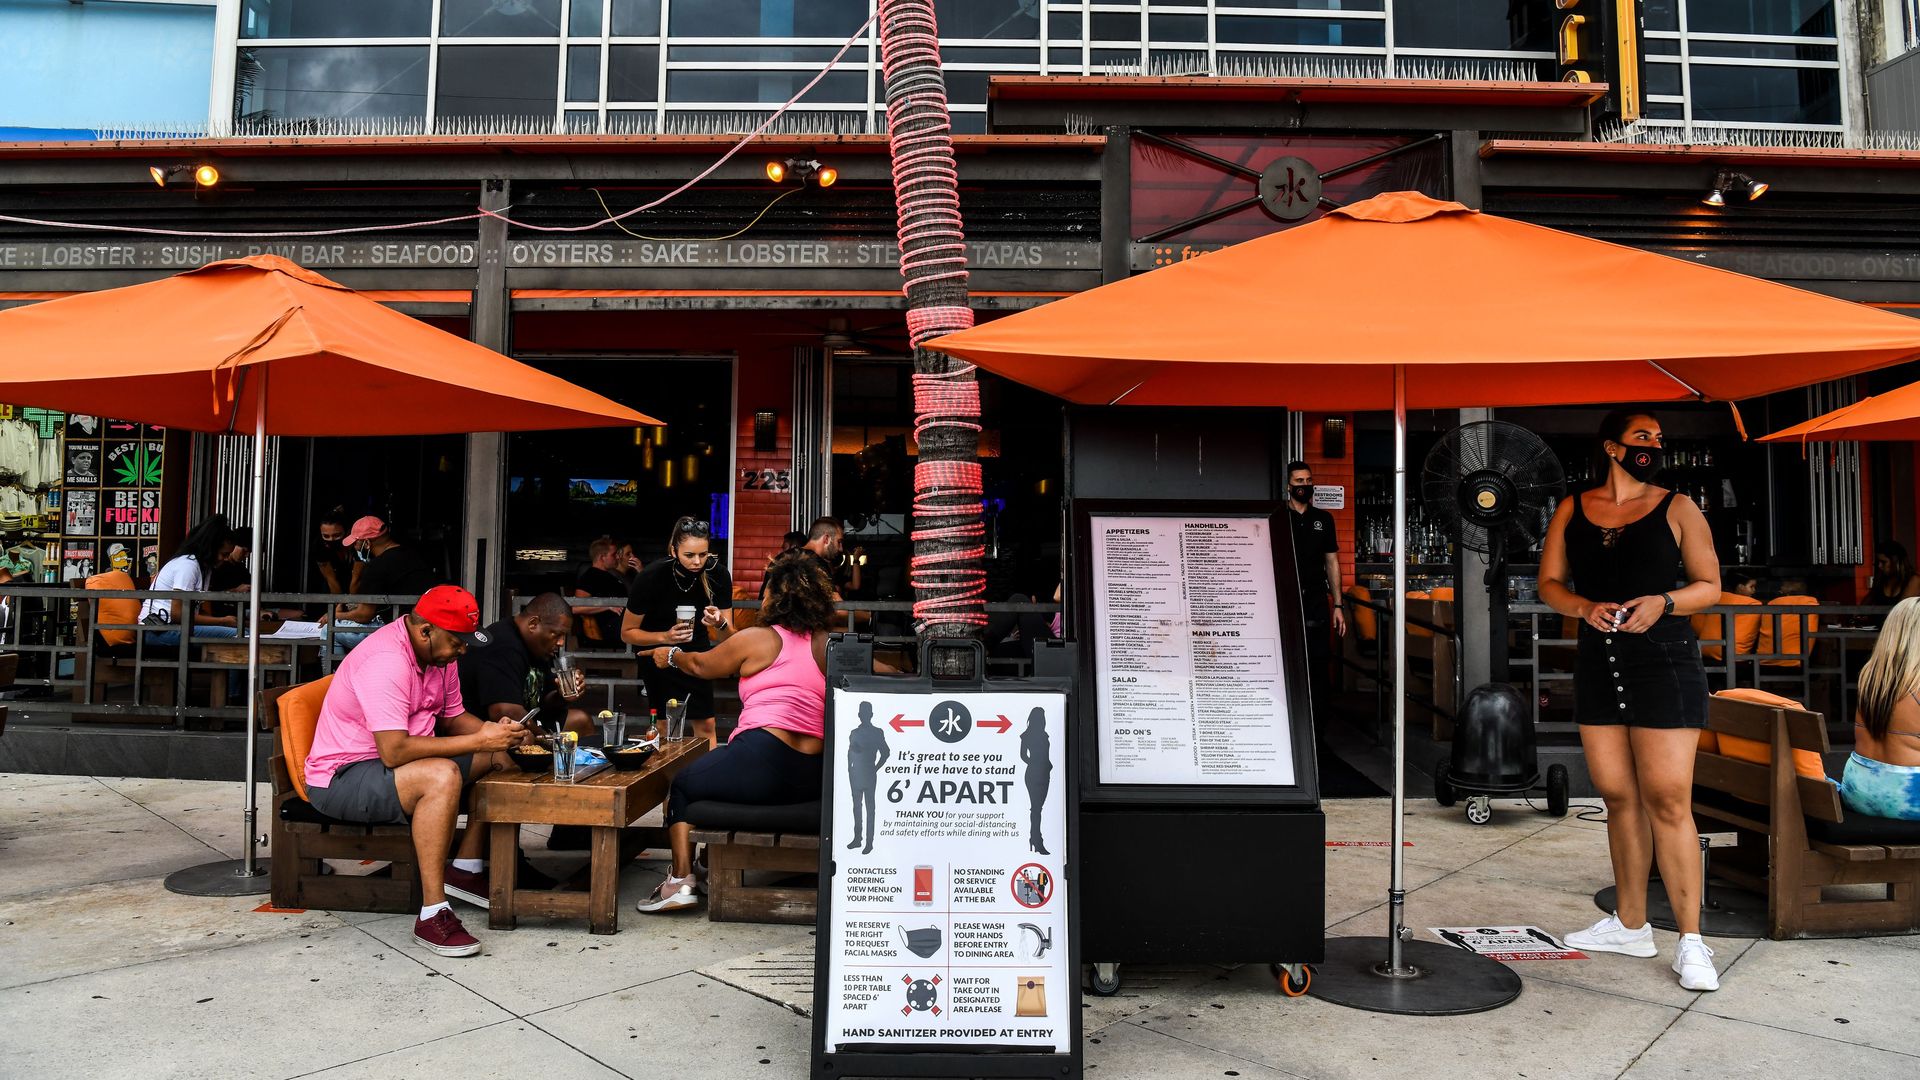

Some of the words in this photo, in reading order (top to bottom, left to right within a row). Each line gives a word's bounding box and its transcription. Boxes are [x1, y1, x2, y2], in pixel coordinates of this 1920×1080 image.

[42, 246, 136, 265] LOBSTER
[161, 246, 222, 264] SUSHI
[302, 246, 345, 264] BAR
[371, 245, 474, 264] SEAFOOD
[513, 244, 613, 264] OYSTERS
[640, 244, 698, 264] SAKE
[728, 245, 829, 264] LOBSTER
[857, 245, 898, 264] STE
[972, 246, 1042, 264] TAPAS
[1736, 255, 1836, 275] SEAFOOD
[1862, 258, 1920, 276] OYST
[108, 443, 135, 461] BEST
[743, 472, 790, 489] 225
[898, 750, 915, 760] It's
[917, 752, 946, 763] great
[949, 752, 960, 761] to
[983, 754, 1002, 763] you
[884, 763, 910, 774] even
[914, 764, 922, 775] if
[942, 764, 968, 774] have
[972, 766, 982, 774] to
[985, 765, 1016, 774] stand
[916, 780, 1014, 804] APART
[883, 820, 892, 828] by
[894, 820, 938, 829] maintaining
[954, 820, 1016, 829] social-distancing
[896, 828, 919, 837] safety
[920, 829, 944, 837] efforts
[968, 829, 991, 838] dining
[843, 1028, 875, 1037] HAND
[878, 1029, 937, 1037] SANITIZER
[940, 1028, 996, 1037] PROVIDED
[1000, 1029, 1014, 1037] AT
[1017, 1029, 1053, 1038] ENTRY
